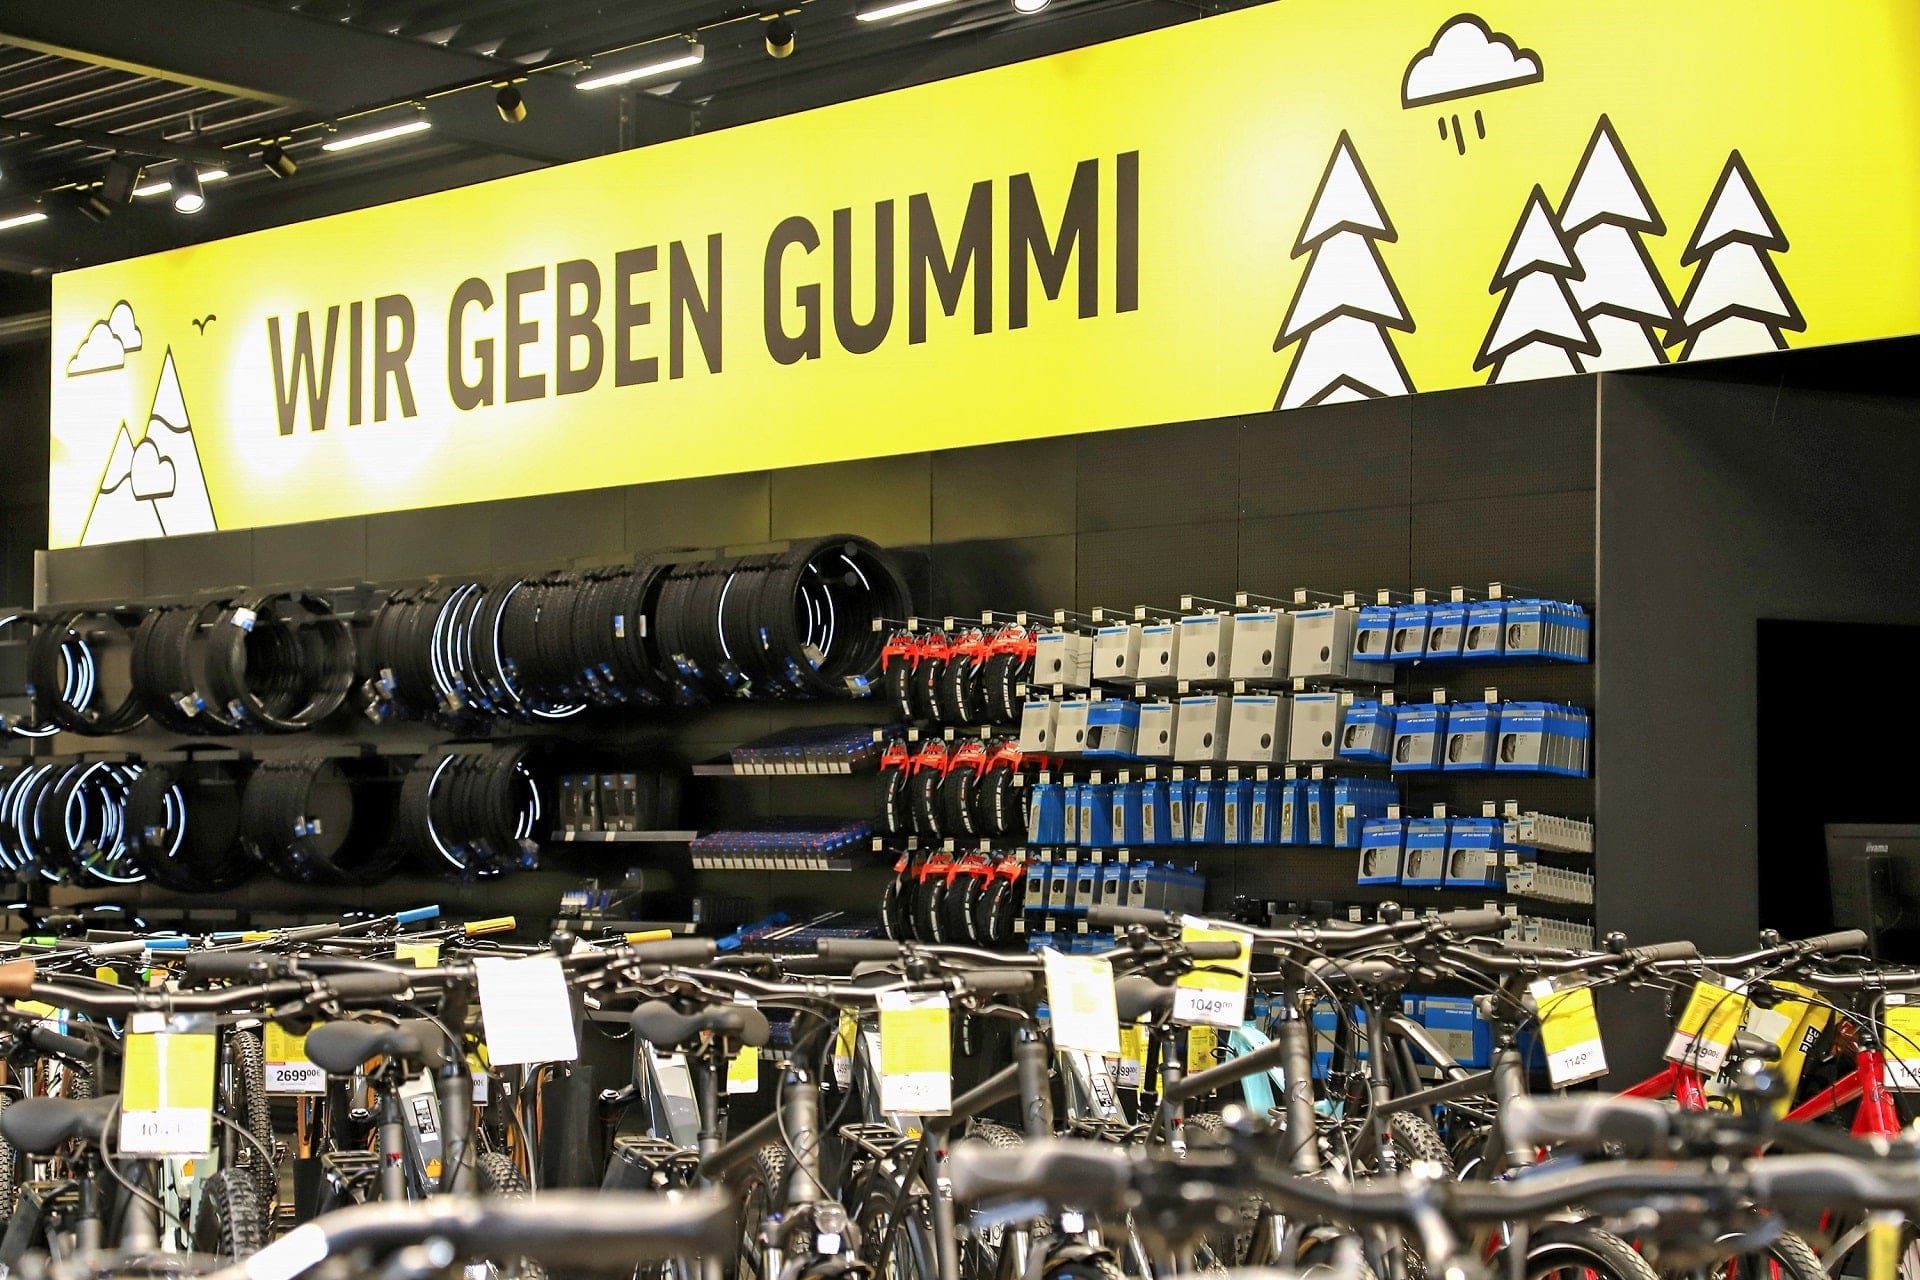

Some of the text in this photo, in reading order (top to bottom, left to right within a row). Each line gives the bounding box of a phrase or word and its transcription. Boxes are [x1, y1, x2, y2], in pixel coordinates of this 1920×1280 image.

[267, 149, 1140, 436] WIR GEBEN GUMMI
